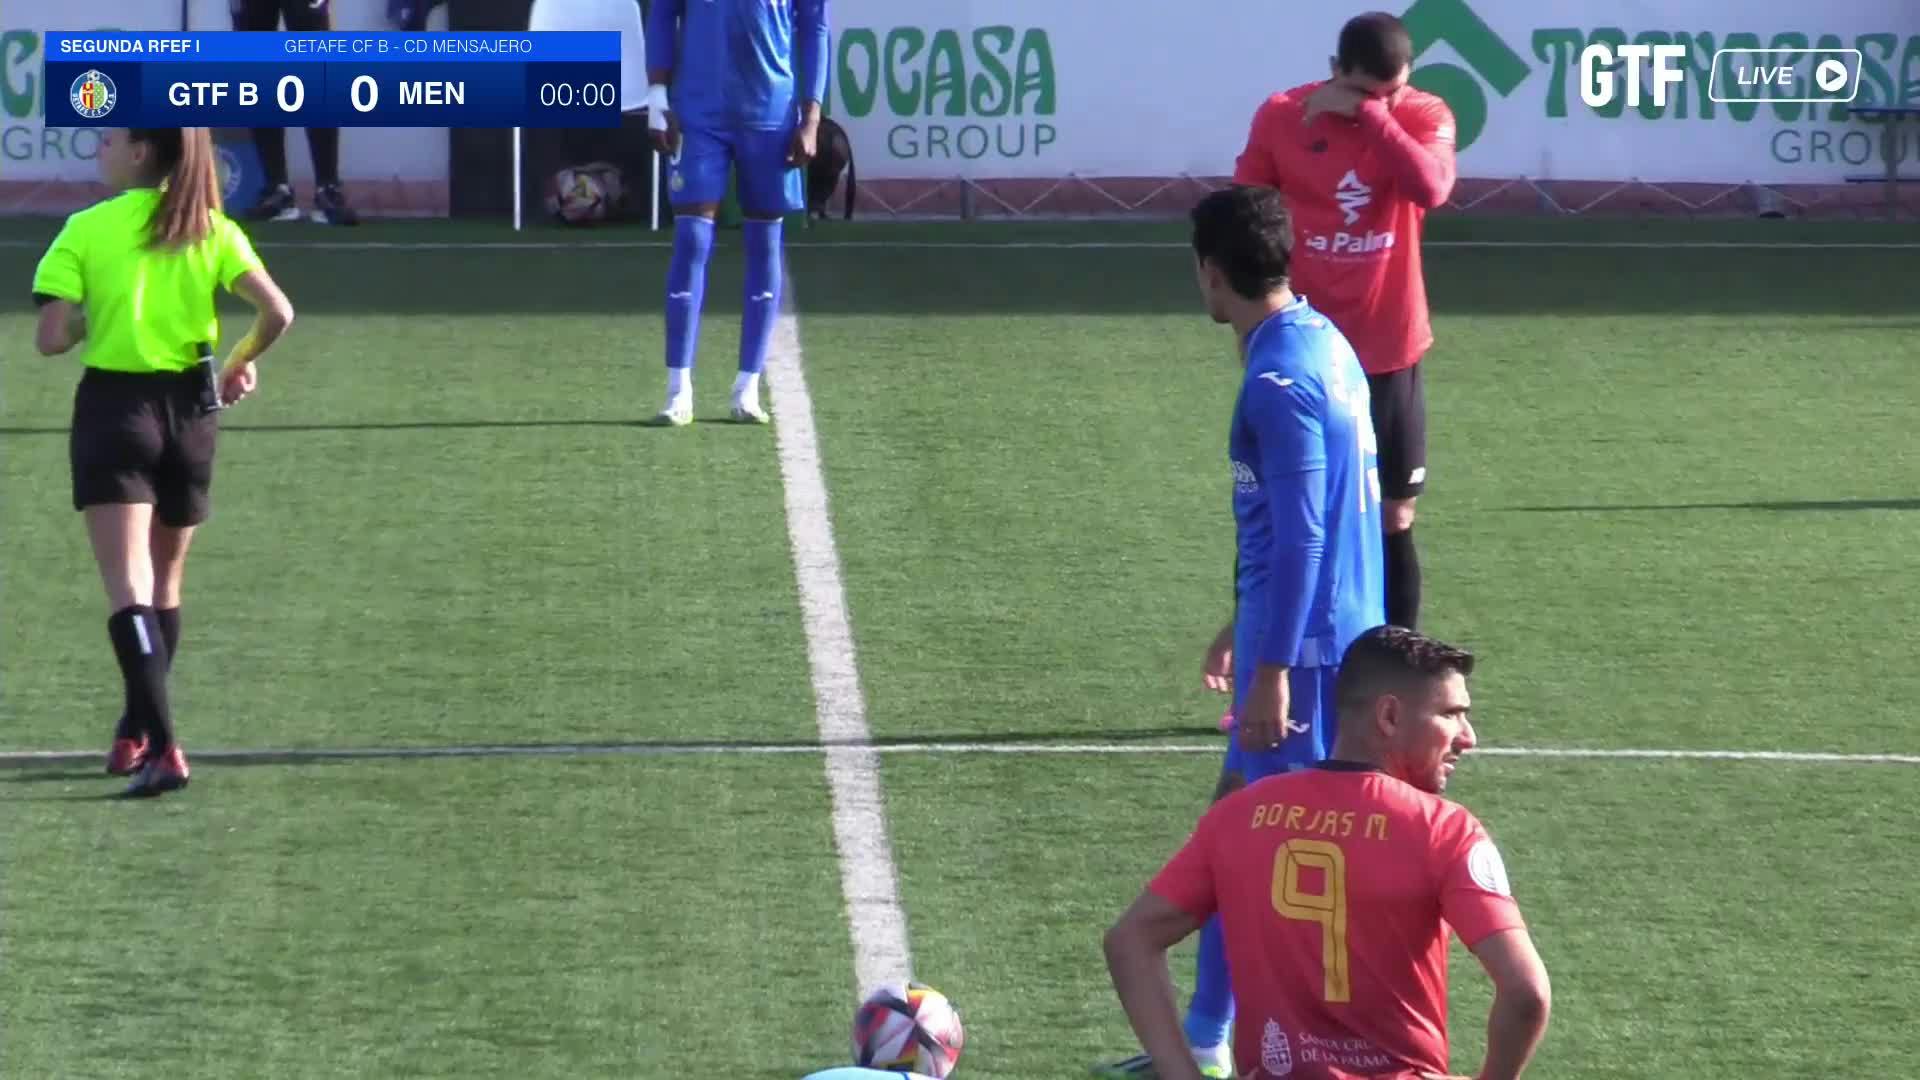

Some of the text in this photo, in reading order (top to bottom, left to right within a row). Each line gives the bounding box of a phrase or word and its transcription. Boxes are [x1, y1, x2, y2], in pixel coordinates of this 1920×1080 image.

[888, 124, 1057, 159] GROUP
[1252, 804, 1355, 837] BORJAS
[1271, 838, 1350, 1003] 9
